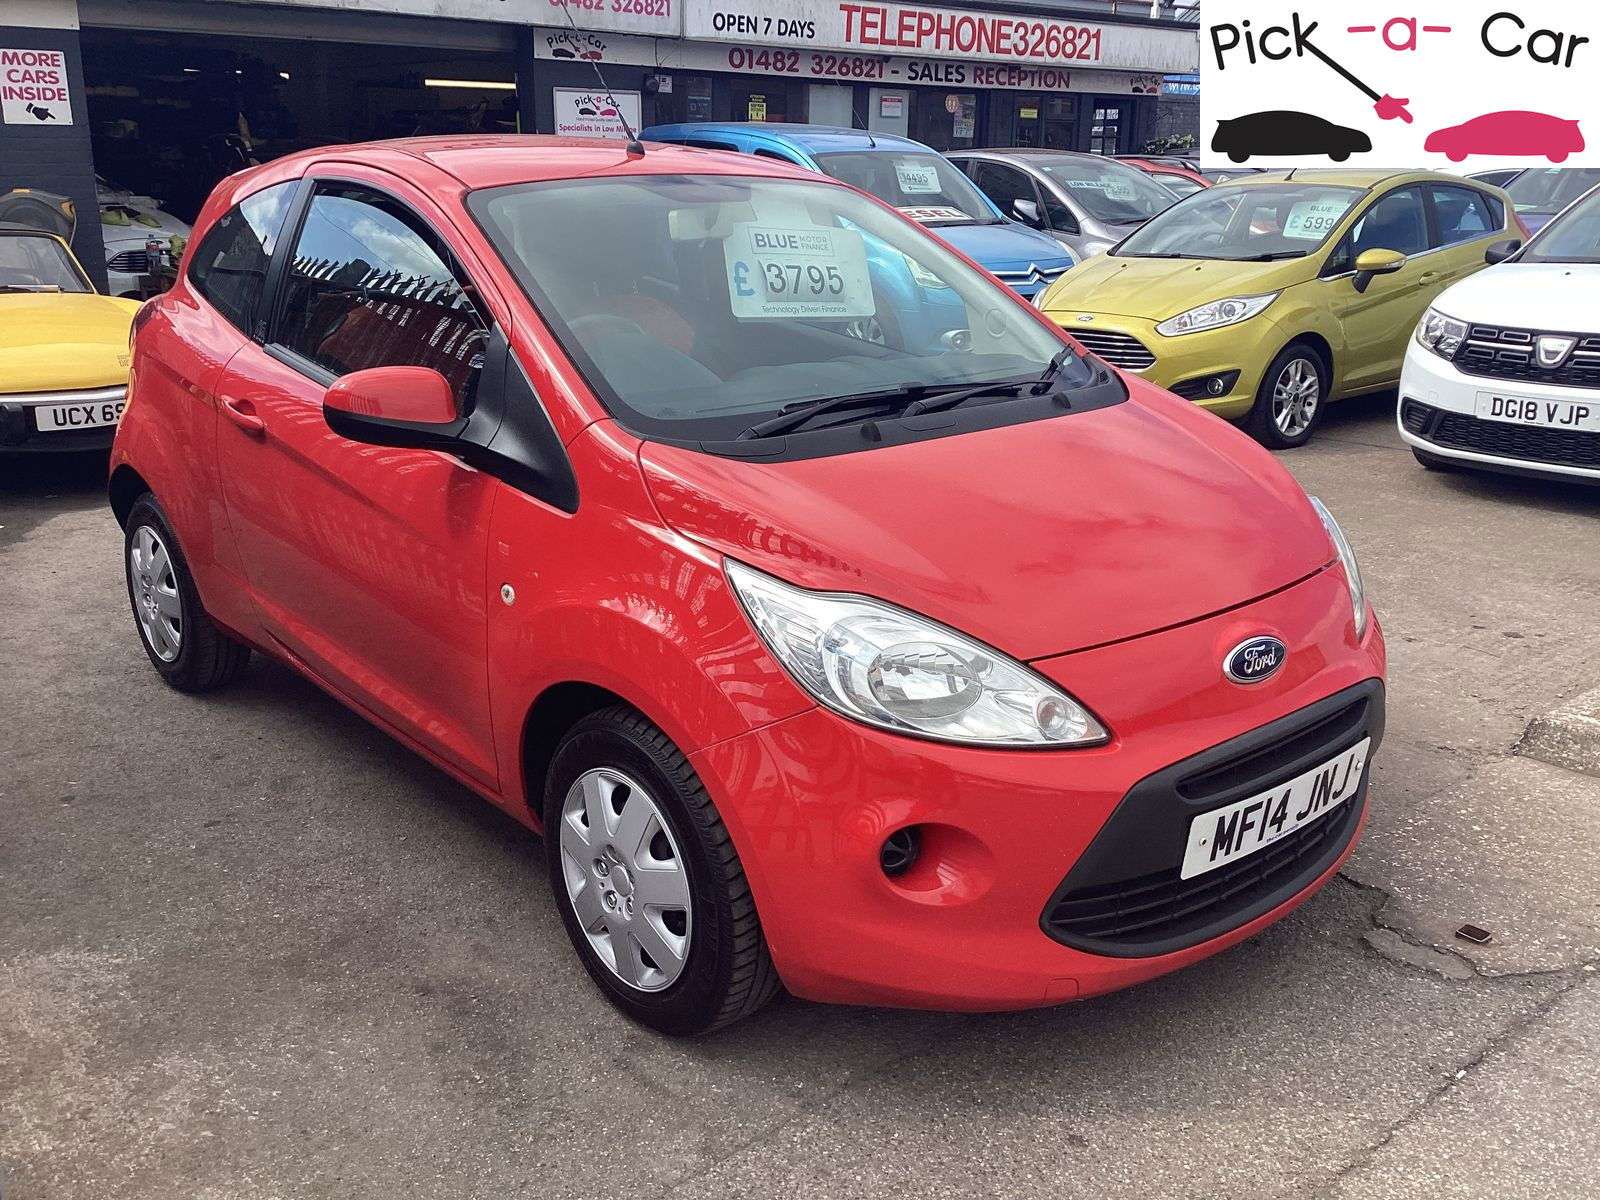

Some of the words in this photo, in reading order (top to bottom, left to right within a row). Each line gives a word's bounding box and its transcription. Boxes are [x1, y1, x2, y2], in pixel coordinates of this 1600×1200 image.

[713, 13, 758, 35] OPEN
[763, 18, 772, 36] 7
[777, 19, 816, 39] DAYS
[2, 51, 61, 67] MORE
[728, 48, 800, 72] 01482
[811, 54, 884, 79] 326821
[907, 61, 966, 84] SALES
[973, 66, 1071, 89] RECEPTION
[7, 69, 60, 84] CARS
[3, 86, 67, 101] INSIDE
[754, 233, 799, 249] BLUE
[734, 261, 755, 297] £
[766, 263, 844, 295] 3795
[762, 305, 799, 314] Technology
[801, 305, 820, 313] Driven
[821, 305, 847, 313] Finance
[53, 406, 97, 427] UCX
[1491, 397, 1538, 420] DG18
[1546, 403, 1590, 426] VJP
[1244, 644, 1277, 674] Ford
[1209, 788, 1291, 862] MF14
[1296, 754, 1355, 821] JNJ
